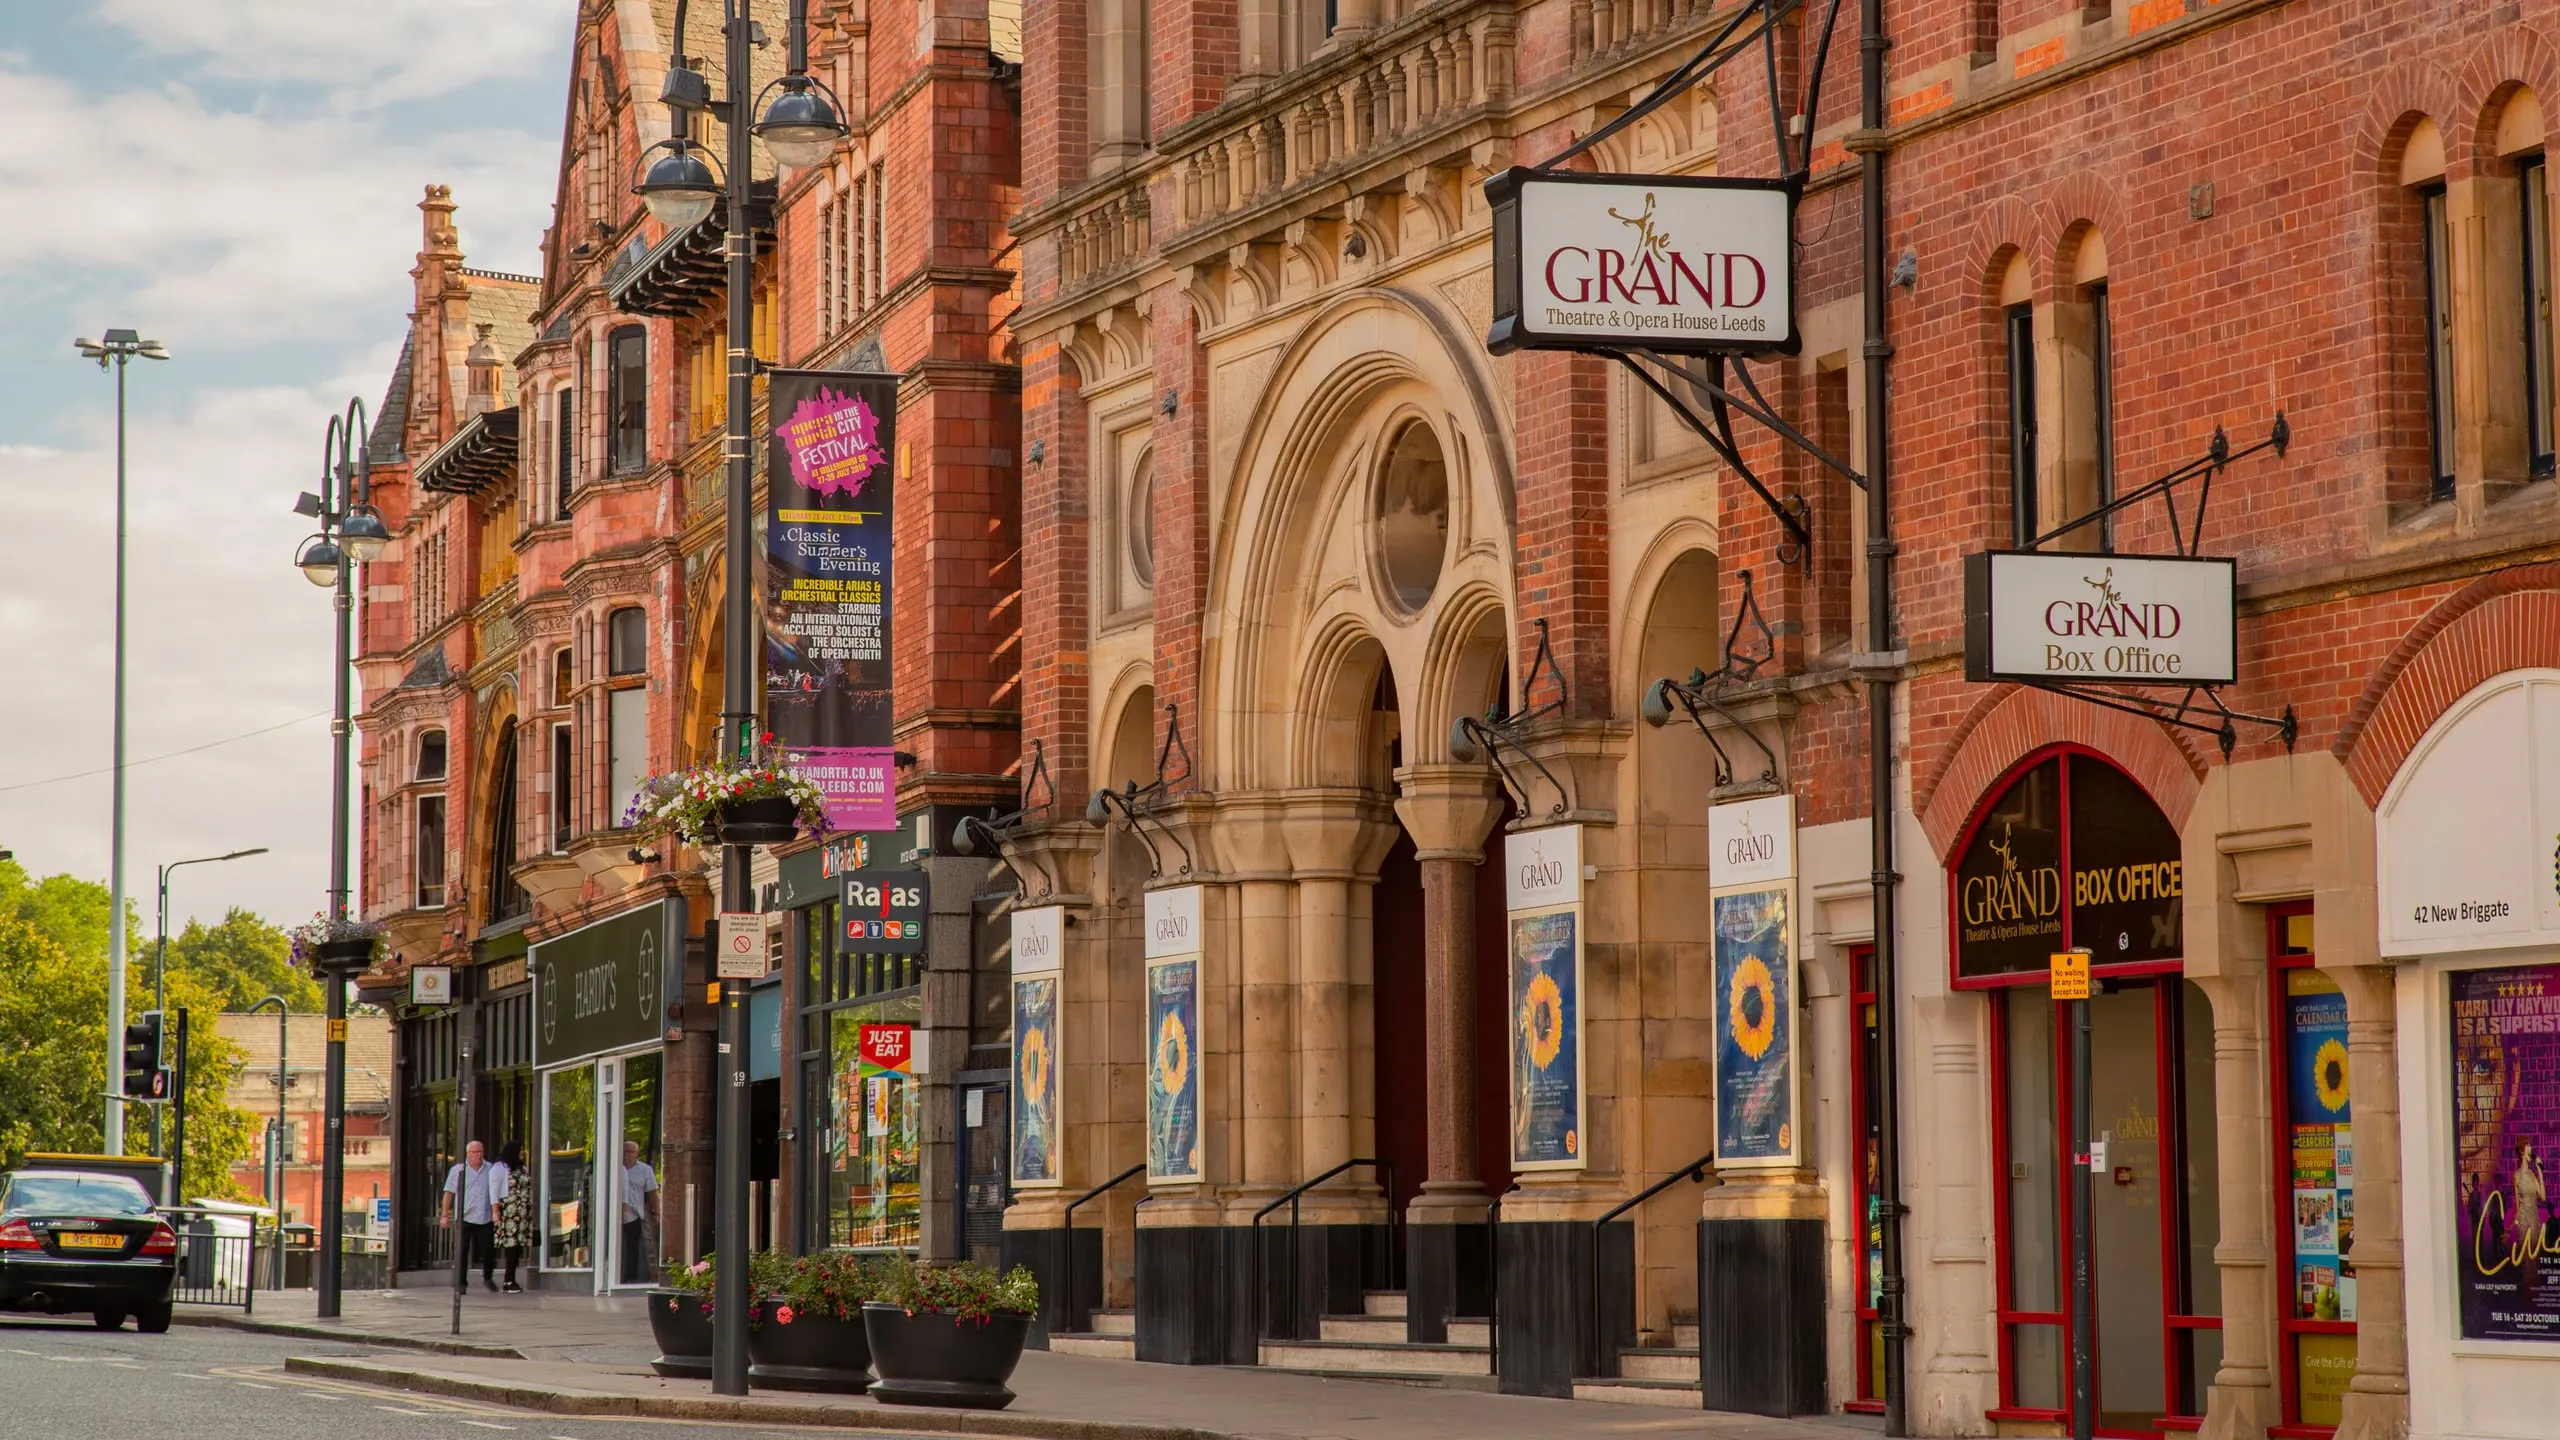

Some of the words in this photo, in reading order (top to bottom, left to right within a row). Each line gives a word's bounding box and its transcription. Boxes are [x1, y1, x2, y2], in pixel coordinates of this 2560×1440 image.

[1545, 246, 1766, 310] GRAND
[1546, 307, 1604, 327] Theatre
[1608, 310, 1620, 326] &
[1623, 310, 1669, 331] Opera
[1673, 312, 1717, 331] House
[1721, 314, 1766, 332] Leeds
[833, 411, 844, 422] IN
[843, 406, 859, 418] THE
[837, 416, 861, 434] CITY
[798, 434, 868, 471] FESTIVAL
[787, 528, 840, 543] Classic
[820, 557, 881, 575] Evening
[793, 578, 844, 591] INCREDIBLE
[846, 580, 871, 591] ARIAS
[874, 582, 881, 591] &
[781, 590, 837, 602] ORCHESTRAL
[839, 592, 881, 603] CLASSICS
[838, 603, 881, 614] STARRING
[790, 613, 802, 623] AN
[805, 614, 881, 626] INTERNATIONALLY
[2045, 600, 2181, 640] GRAND
[783, 624, 833, 636] ACCLAIMED
[836, 626, 871, 637] SOLOIST
[874, 627, 881, 637] &
[812, 637, 829, 647] THE
[831, 637, 881, 648] ORCHESTRA
[808, 648, 819, 659] OF
[822, 648, 850, 659] OPERA
[852, 649, 881, 660] NORTH
[2045, 644, 2096, 672] Box
[2104, 646, 2181, 674] Office
[1727, 833, 1774, 865] GRAND
[1521, 861, 1563, 890] GRAND
[847, 880, 921, 919] Rajas
[1964, 867, 2061, 925] GRAND
[2075, 868, 2113, 907] BOX
[2117, 860, 2182, 902] OFFICE
[2414, 906, 2428, 924] 42
[2431, 904, 2458, 923] New
[2461, 900, 2509, 923] Briggate
[1156, 915, 1188, 941] GRAND
[1965, 928, 1990, 943] Theatre
[1991, 925, 1998, 940] &
[1997, 925, 2018, 941] Opera
[2018, 922, 2040, 937] House
[2040, 919, 2061, 934] Leeds
[1020, 935, 1049, 958] GRAND
[2064, 969, 2085, 978] waiting
[2054, 988, 2072, 996] except
[2062, 980, 2072, 988] any
[2456, 1000, 2489, 1018] KARA
[2491, 998, 2515, 1016] LILY
[2295, 1010, 2340, 1026] CALENDAR
[2458, 1017, 2473, 1035] IS
[2476, 1016, 2487, 1035] A
[867, 1030, 903, 1046] JUST
[875, 1044, 903, 1058] EAT
[733, 1071, 745, 1082] 19
[2117, 1116, 2159, 1139] GRAND
[2298, 1136, 2334, 1148] SEARCHERS
[2540, 1256, 2552, 1264] THE
[2547, 1276, 2559, 1285] JEFF
[2492, 1312, 2503, 1322] TUE
[2504, 1312, 2511, 1322] 16
[2514, 1313, 2524, 1322] SAT
[2525, 1313, 2532, 1322] 20
[2533, 1314, 2560, 1323] OCTOBER
[2306, 1355, 2320, 1367] Give
[2321, 1357, 2332, 1368] the
[2334, 1357, 2346, 1369] Gift
[2347, 1357, 2355, 1369] of
